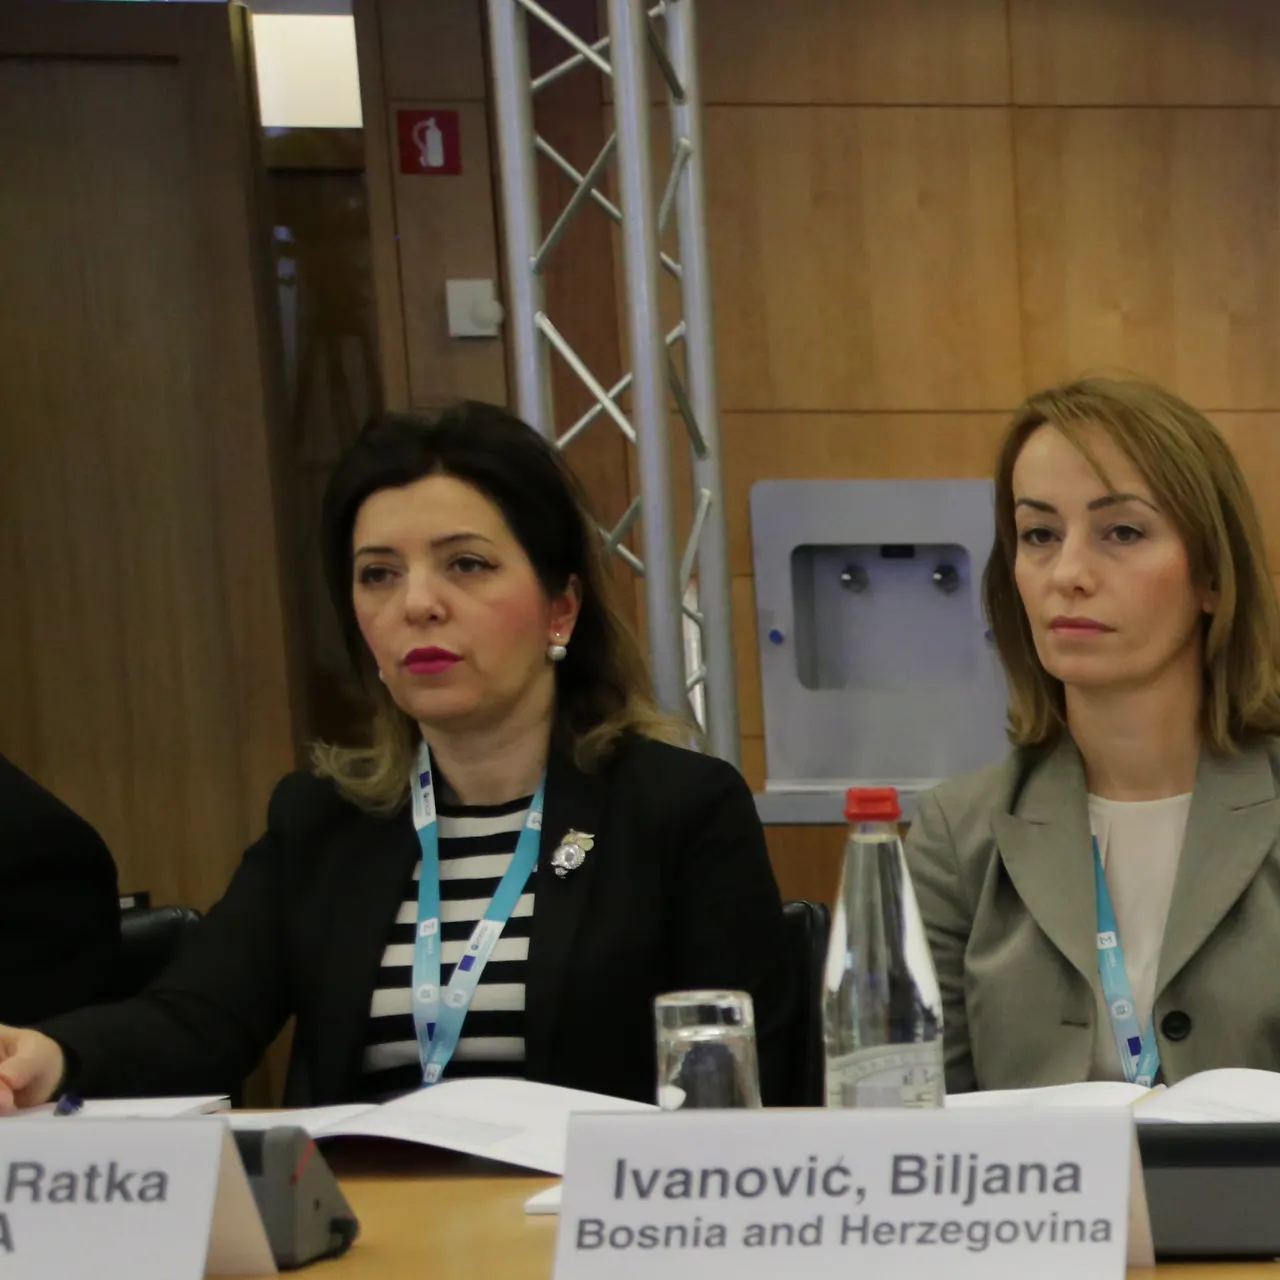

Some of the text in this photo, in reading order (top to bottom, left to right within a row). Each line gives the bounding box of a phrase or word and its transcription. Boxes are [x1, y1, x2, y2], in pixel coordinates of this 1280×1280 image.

[4, 1160, 169, 1204] Ratka
[613, 1153, 1081, 1206] Ivanović, Biljana
[575, 1212, 1112, 1253] Bosnia and Herzegovina
